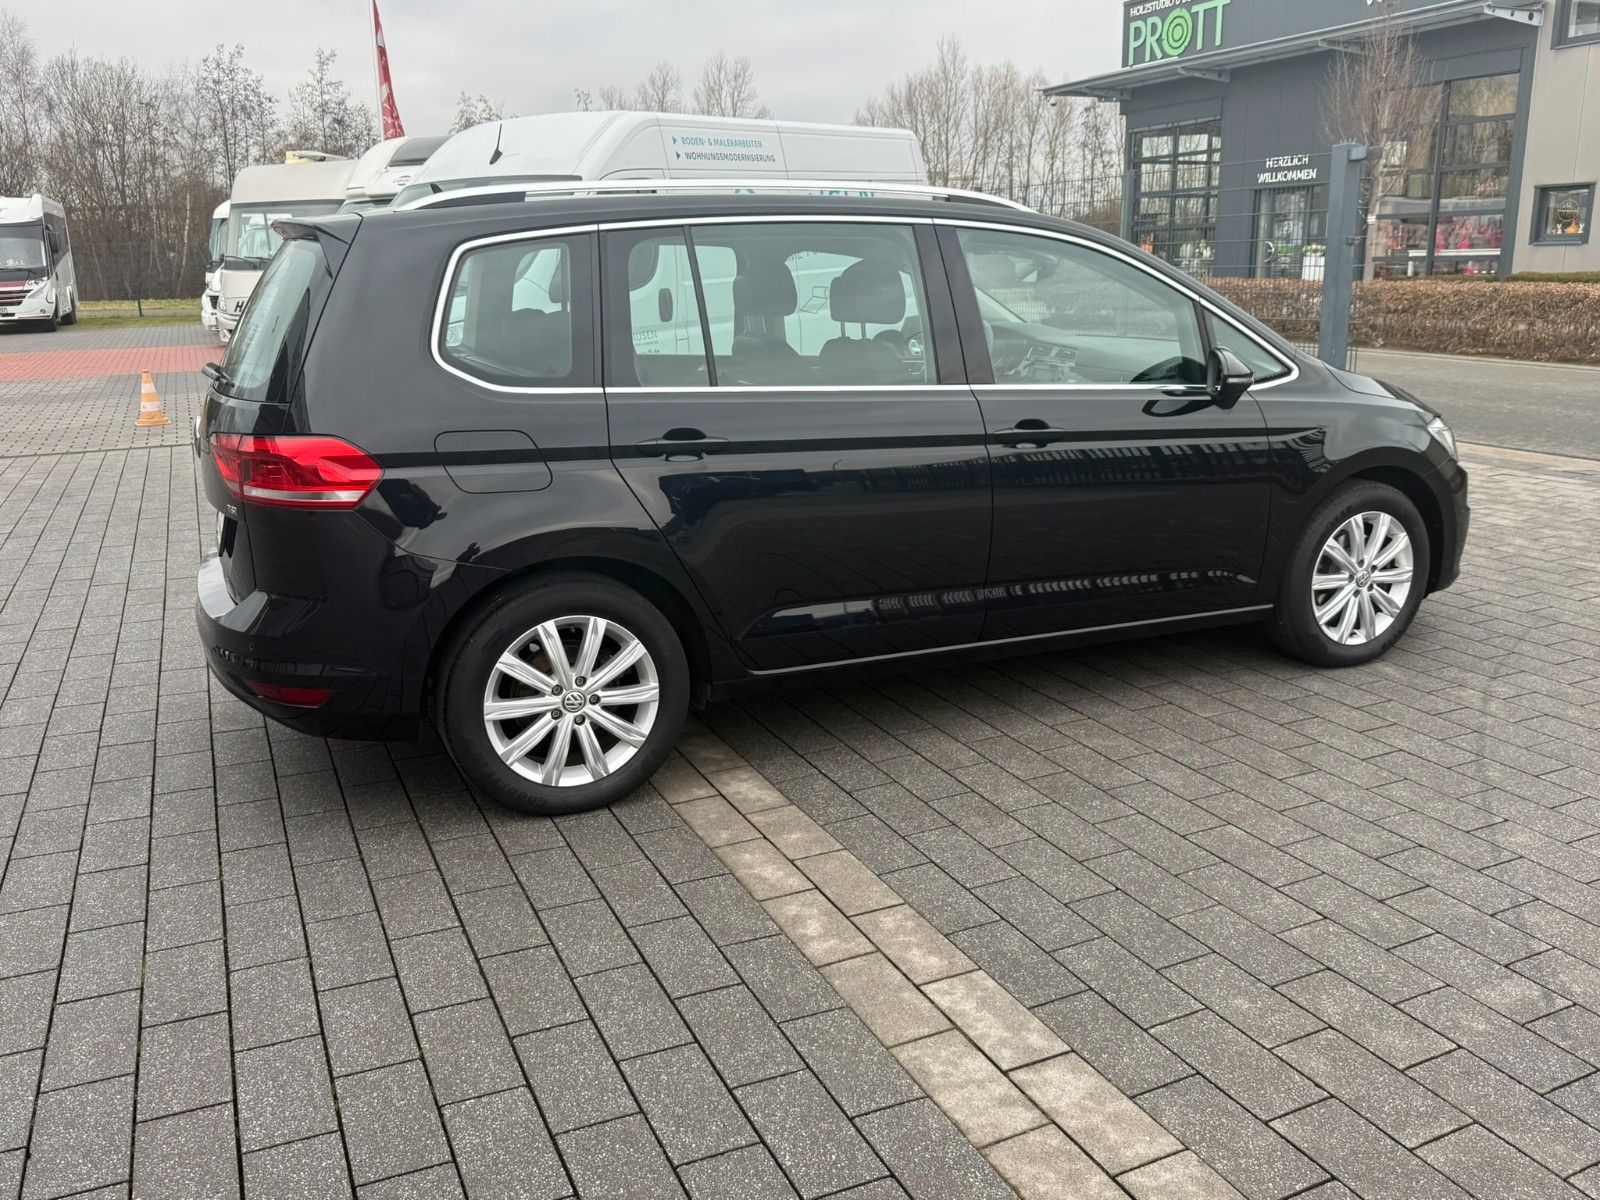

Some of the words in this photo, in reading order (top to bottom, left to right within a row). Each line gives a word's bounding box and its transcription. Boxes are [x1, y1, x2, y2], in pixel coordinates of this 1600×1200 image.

[1130, 0, 1174, 17] HOLZSTUDIO
[1128, 0, 1231, 66] PROTT
[681, 136, 706, 146] BODEN-
[714, 138, 763, 149] MALERARBEITEN
[684, 151, 776, 163] WOHNUNGSMODERNISIERUNG
[1265, 154, 1309, 168] HERZLICH
[1257, 168, 1318, 183] WILLKOMMEN
